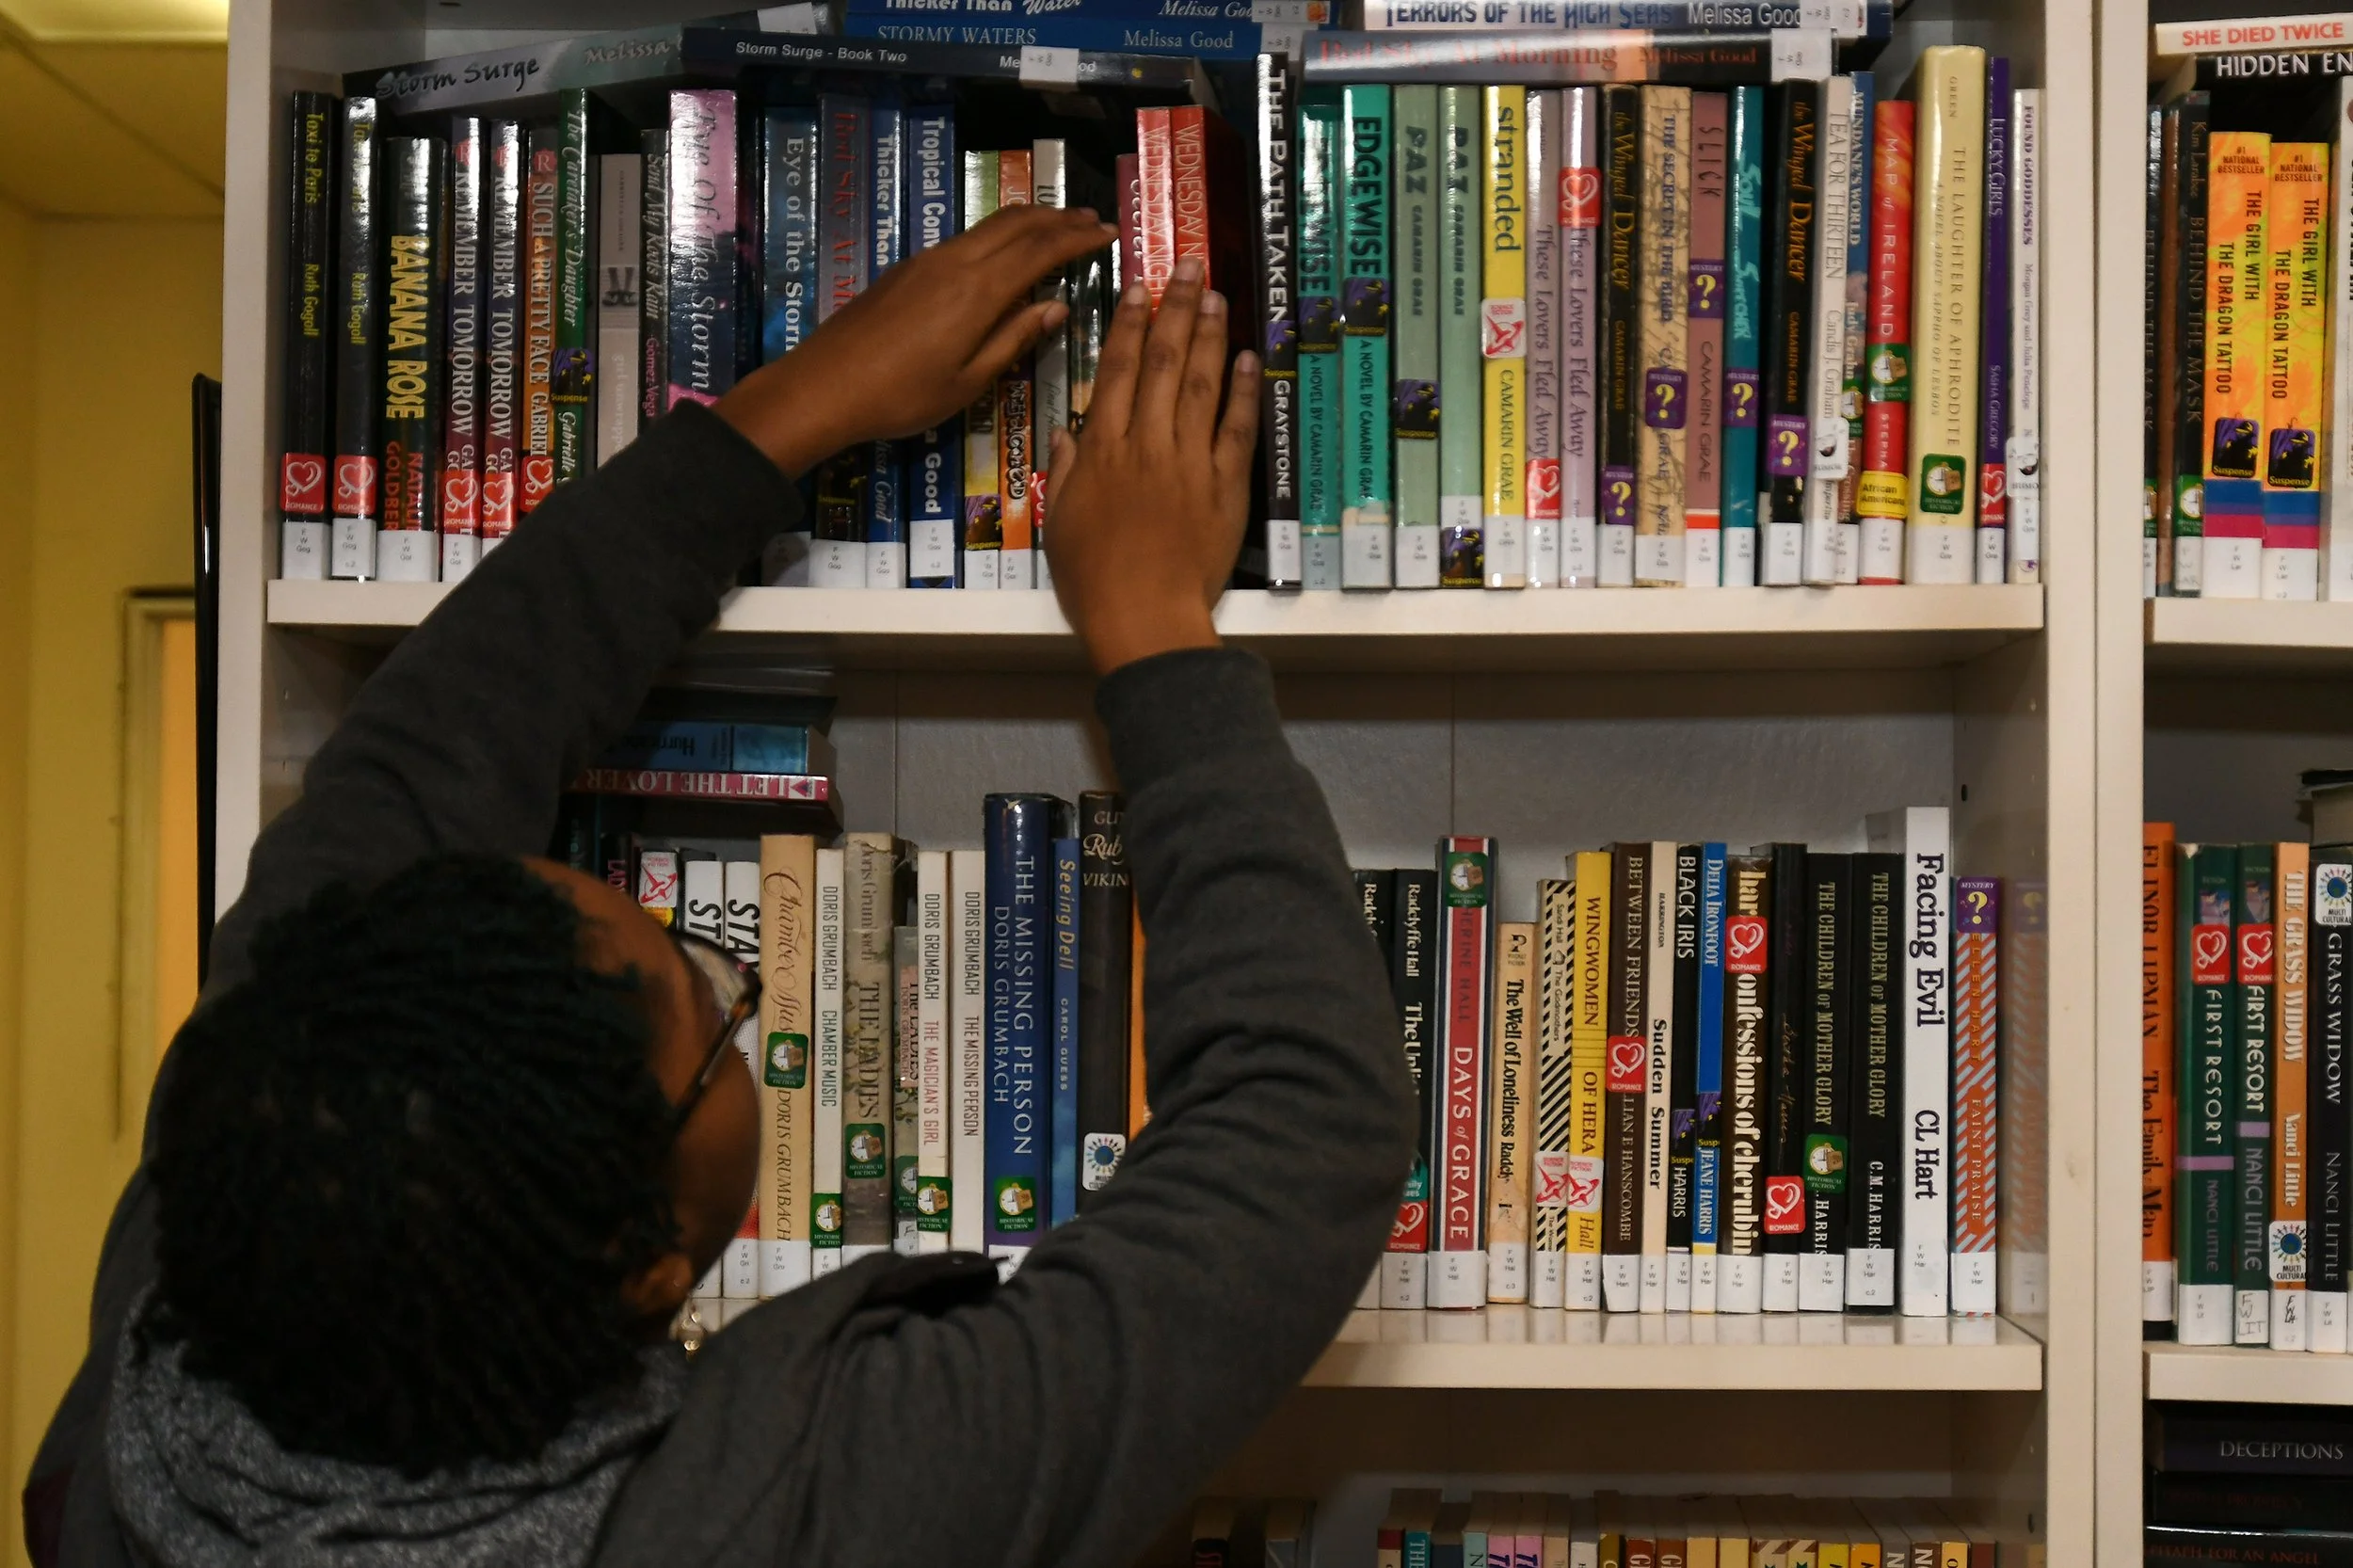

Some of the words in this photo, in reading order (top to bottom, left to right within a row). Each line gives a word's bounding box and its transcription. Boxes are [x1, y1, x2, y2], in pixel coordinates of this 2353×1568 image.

[878, 24, 952, 43] STORMY
[960, 27, 1037, 49] WATERS
[1124, 30, 1182, 49] Melissa
[1190, 31, 1235, 49] Good
[1385, 1, 1476, 26] TERRORS
[1484, 1, 1508, 23] OF
[1517, 1, 1557, 23] THE
[1564, 2, 1610, 28] HIGH
[2183, 28, 2222, 46] SHE
[2227, 25, 2276, 44] DIED
[2280, 22, 2345, 41] TWICE
[376, 69, 457, 99] Storm
[464, 54, 540, 92] Surge
[736, 41, 776, 56] Storm
[781, 44, 824, 60] Surge
[838, 47, 873, 61] Book
[879, 50, 907, 62] Two
[304, 113, 324, 143] Taxi
[1988, 118, 2007, 170] LUCKY
[2023, 105, 2035, 154] FOUND
[2190, 120, 2207, 149] Kim
[304, 148, 324, 162] to
[875, 134, 894, 211] Thicker
[1175, 123, 1205, 237] WEDNESDAY
[1405, 125, 1428, 194] PAZ
[1494, 105, 1522, 253] stranded
[1697, 125, 1725, 202] SLICK
[1885, 137, 1899, 189] MAP
[2190, 152, 2207, 198] Larabee
[2217, 165, 2265, 174] BESTSELLER
[2222, 155, 2260, 165] NATIONAL
[304, 168, 324, 203] Paris
[529, 183, 554, 238] SUCH
[1350, 116, 1383, 275] EDGEWISE
[1883, 197, 1896, 213] of
[1988, 171, 2007, 218] GIRLS
[2023, 157, 2035, 247] GODDESSES
[2245, 190, 2262, 217] THE
[452, 170, 476, 296] REMEMBER
[2302, 198, 2319, 225] THE
[489, 176, 516, 300] REMEMBER
[529, 241, 554, 256] A
[875, 215, 894, 265] Than
[1533, 224, 1556, 280] These
[2217, 242, 2235, 269] THE
[2245, 223, 2262, 257] GIRL
[2274, 248, 2292, 276] THE
[2302, 231, 2319, 264] GIRL
[387, 235, 431, 352] BANANA
[529, 258, 554, 332] PRETTY
[1881, 224, 1897, 338] IRELAND
[2217, 275, 2235, 336] DRAGON
[2245, 263, 2262, 300] WITH
[2302, 270, 2319, 307] WITH
[1533, 290, 1556, 349] Lovers
[2274, 282, 2292, 343] DRAGON
[528, 334, 552, 384] FACE
[1359, 339, 1374, 348] A
[2216, 341, 2233, 394] TATTOO
[385, 360, 428, 420] ROSE
[451, 305, 475, 438] TOMORROW
[488, 307, 514, 441] TOMORROW
[1359, 350, 1374, 390] NOVEL
[1533, 358, 1556, 399] Fled
[1698, 341, 1714, 427] CAMARIN
[1988, 364, 2003, 398] SASHA
[2272, 347, 2289, 400] TATTOO
[1359, 393, 1374, 408] BY
[1498, 368, 1515, 449] CAMARIN
[1988, 399, 2003, 450] GREGORY
[1273, 379, 1293, 501] GRAYSTONE
[1359, 410, 1374, 463] CAMARIN
[1528, 404, 1555, 459] Away
[1359, 468, 1374, 499] GRAE
[1498, 453, 1515, 501] GRAE
[1698, 433, 1714, 484] GRAE
[2269, 475, 2311, 489] Suspense
[821, 886, 839, 921] DORIS
[1014, 855, 1035, 906] THE
[1055, 858, 1077, 928] Seeing
[1625, 855, 1644, 951] BETWEEN
[1677, 855, 1697, 918] BLACK
[1868, 872, 1890, 902] THE
[1960, 882, 1995, 890] MYSTERY
[2283, 871, 2306, 912] THE
[963, 891, 981, 928] DORIS
[1555, 903, 1565, 924] Sandi
[1657, 892, 1667, 949] HARRINGTON
[1909, 853, 1946, 960] Facing
[821, 924, 839, 991] GRUMBACH
[993, 905, 1010, 970] DORIS
[1055, 930, 1077, 972] Dell
[1555, 926, 1565, 945] Hall
[1677, 922, 1697, 959] IRIS
[1868, 904, 1890, 982] CHILDREN
[2283, 916, 2306, 985] GRASS
[963, 929, 981, 997] GRUMBACH
[1014, 916, 1035, 1032] MISSING
[1553, 970, 1564, 986] The
[1584, 896, 1602, 1028] WINGWOMEN
[2326, 932, 2345, 1005] GRASS
[901, 986, 911, 1017] DORIS
[1552, 988, 1563, 1042] Godmothers
[1624, 955, 1644, 1038] FRIENDS
[1870, 984, 1884, 1000] OF
[1916, 968, 1946, 1028] Evil
[2244, 984, 2265, 1034] FIRST
[821, 1010, 839, 1066] CHAMBER
[963, 1016, 981, 1036] THE
[993, 978, 1010, 1103] GRUMBACH
[1059, 998, 1070, 1043] CAROL
[1868, 1002, 1890, 1065] MOTHER
[2205, 988, 2224, 1048] FIRST
[2283, 989, 2306, 1065] WIDOW
[901, 1019, 911, 1075] GRUMBACH
[963, 1039, 981, 1088] MISSING
[1059, 1047, 1070, 1092] GUESS
[1652, 1018, 1668, 1094] Sudden
[2325, 1010, 2343, 1105] WIDOW
[821, 1069, 839, 1108] MUSIC
[1012, 1044, 1034, 1156] PERSON
[1452, 1047, 1475, 1121] DAYS
[1581, 1071, 1598, 1096] OF
[1868, 1067, 1890, 1118] GLORY
[2205, 1054, 2224, 1145] RESORT
[2244, 1037, 2265, 1113] RESORT
[776, 1087, 792, 1141] DORIS
[963, 1090, 981, 1137] PERSON
[1453, 1126, 1467, 1140] of
[1581, 1101, 1598, 1154] HERA
[1915, 1110, 1941, 1143] CL
[2283, 1112, 2302, 1158] Nanci
[1649, 1105, 1666, 1190] Summer
[776, 1143, 792, 1241] GRUMBACH
[1449, 1144, 1471, 1240] GRACE
[1673, 1165, 1689, 1218] HARRIS
[1915, 1147, 1941, 1200] Hart
[2244, 1147, 2264, 1206] NANCI
[2283, 1161, 2302, 1208] Little
[1769, 1223, 1801, 1232] ROMANCE
[2244, 1211, 2264, 1272] LITTLE
[2282, 1264, 2302, 1272] MULTI
[2236, 1320, 2267, 1336] LIT
[2218, 1440, 2345, 1461] DECEPTIONS
